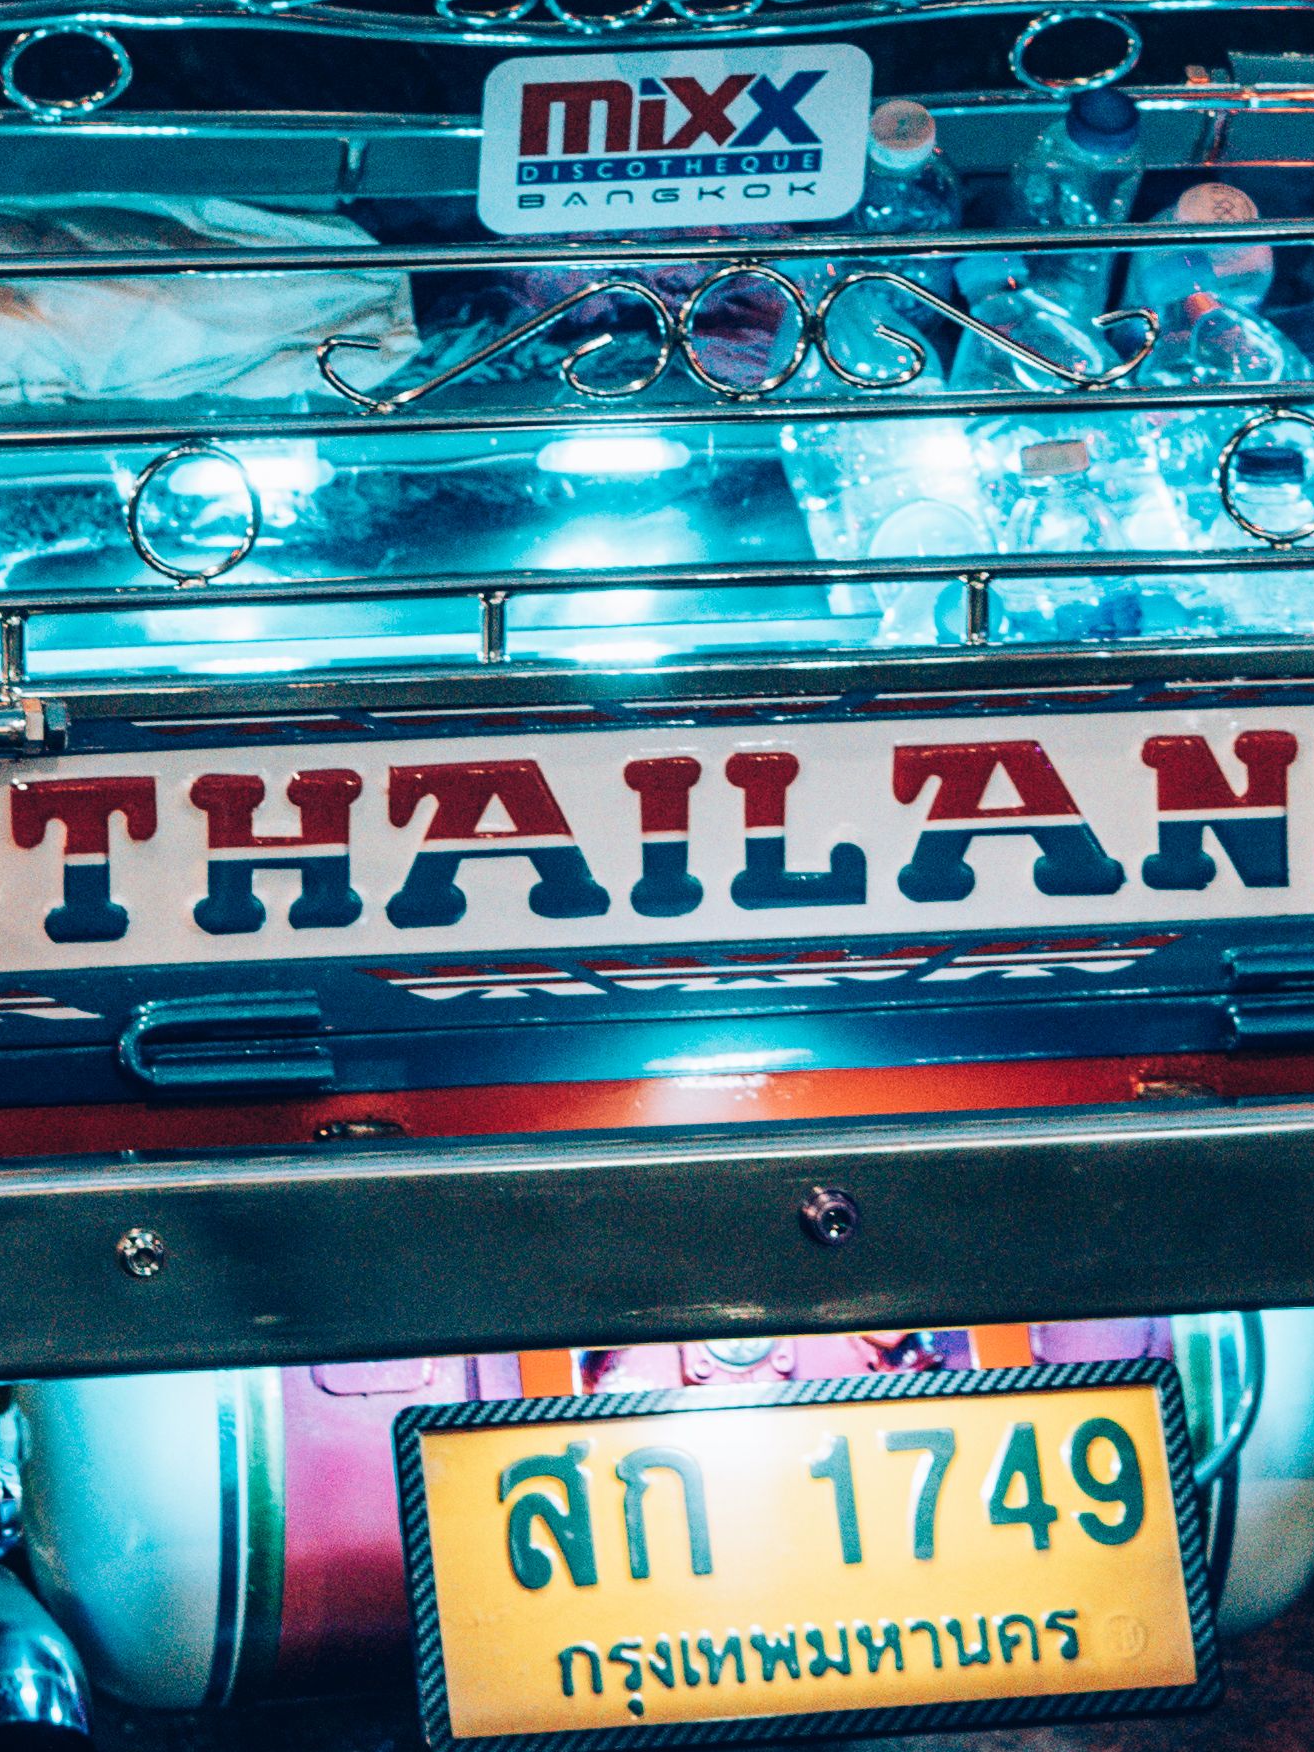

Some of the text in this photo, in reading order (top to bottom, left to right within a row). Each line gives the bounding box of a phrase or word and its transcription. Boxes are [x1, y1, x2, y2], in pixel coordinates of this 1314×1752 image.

[518, 181, 817, 209] BANGKOK
[522, 152, 816, 183] DISCOTHEQUE
[497, 1416, 1146, 1590] สก 1749
[557, 1607, 1080, 1718] กรุงเทพมหานคร
